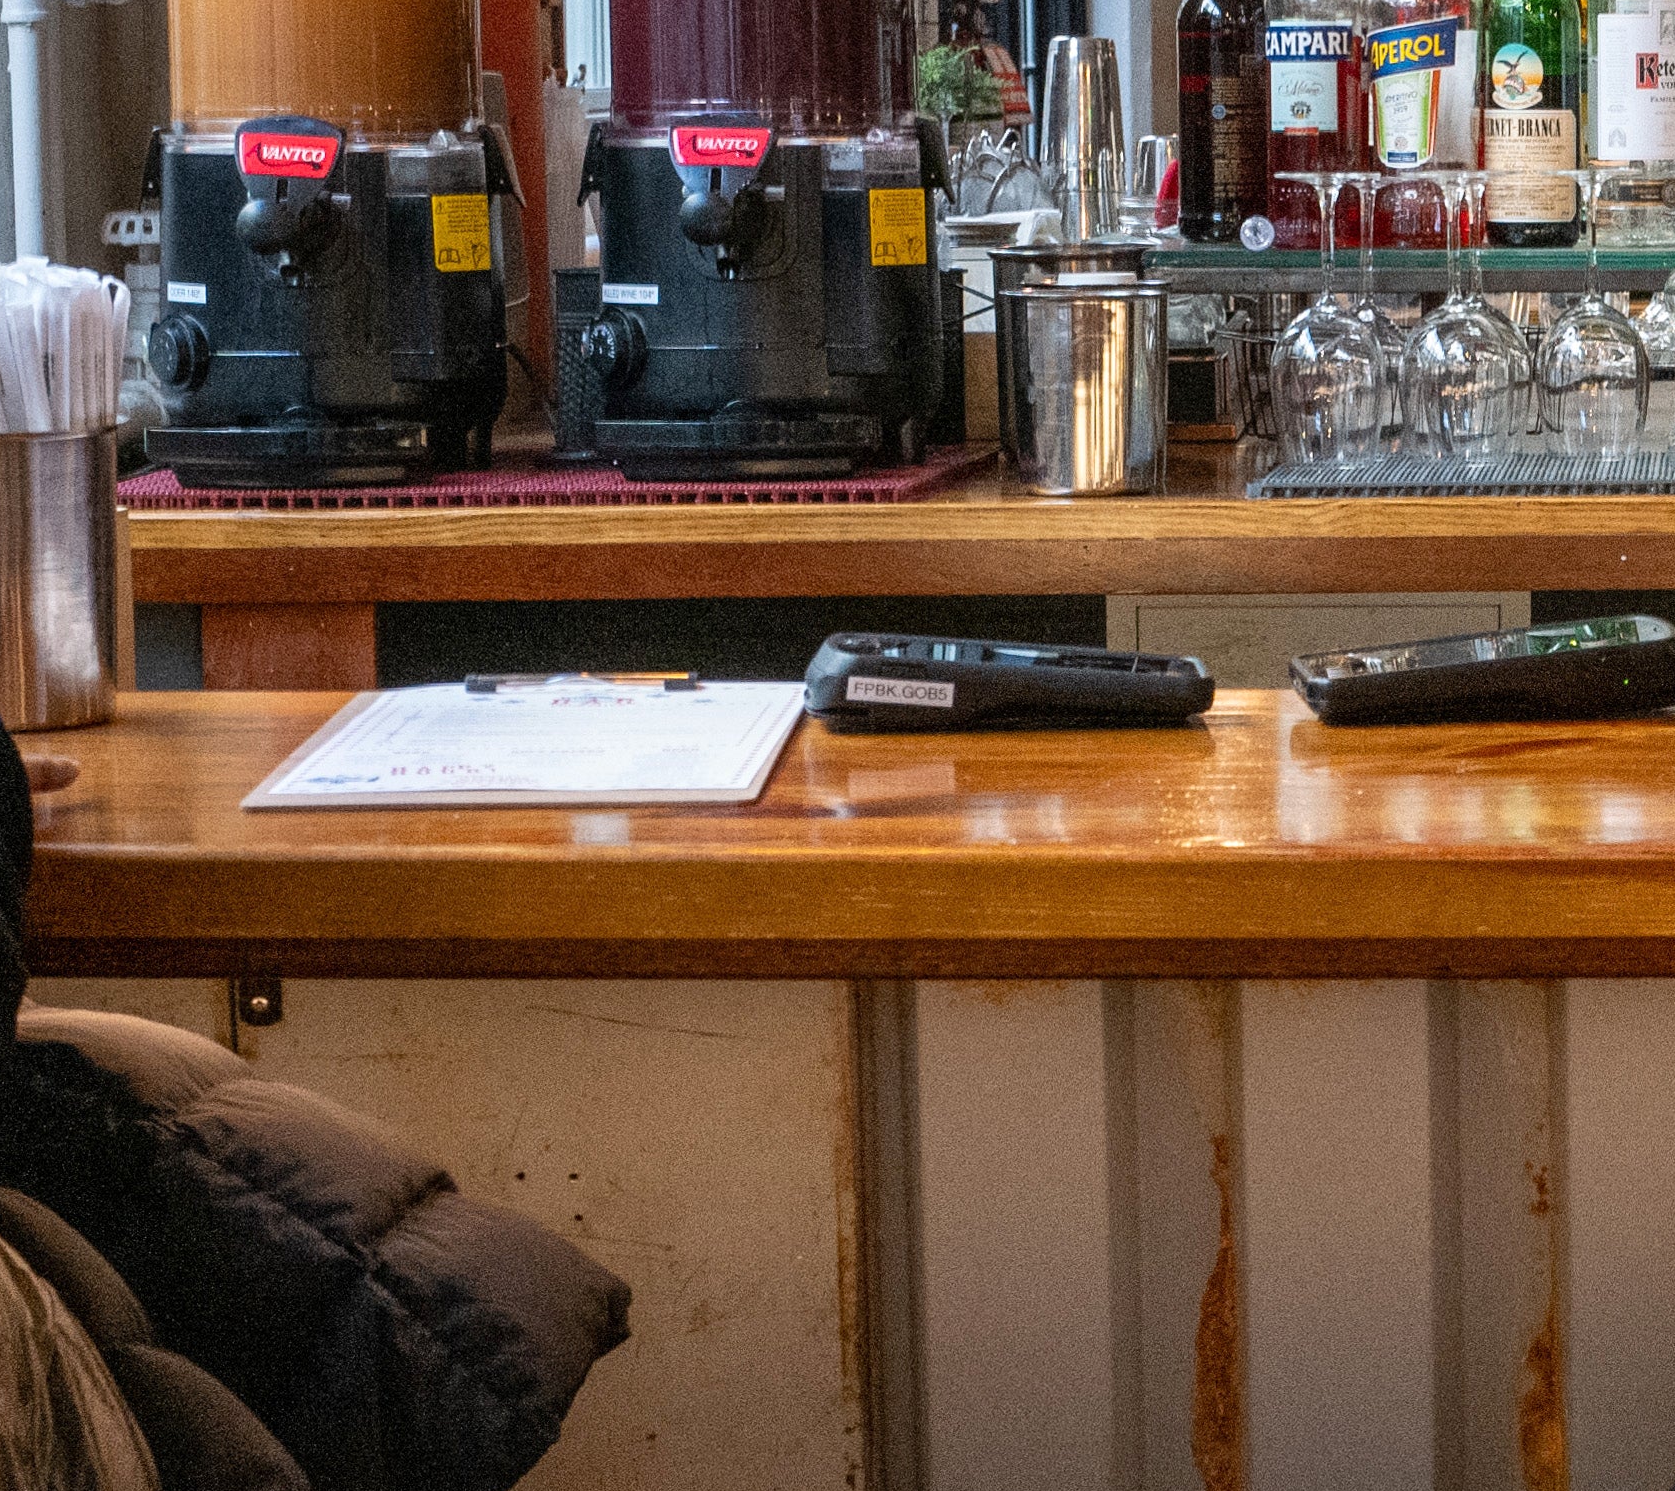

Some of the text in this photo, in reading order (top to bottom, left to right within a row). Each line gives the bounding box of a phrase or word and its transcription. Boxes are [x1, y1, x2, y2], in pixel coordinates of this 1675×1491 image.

[1265, 30, 1350, 57] CAMPARI
[1371, 34, 1445, 70] APEROL
[1485, 118, 1561, 138] RNET-BRANCA
